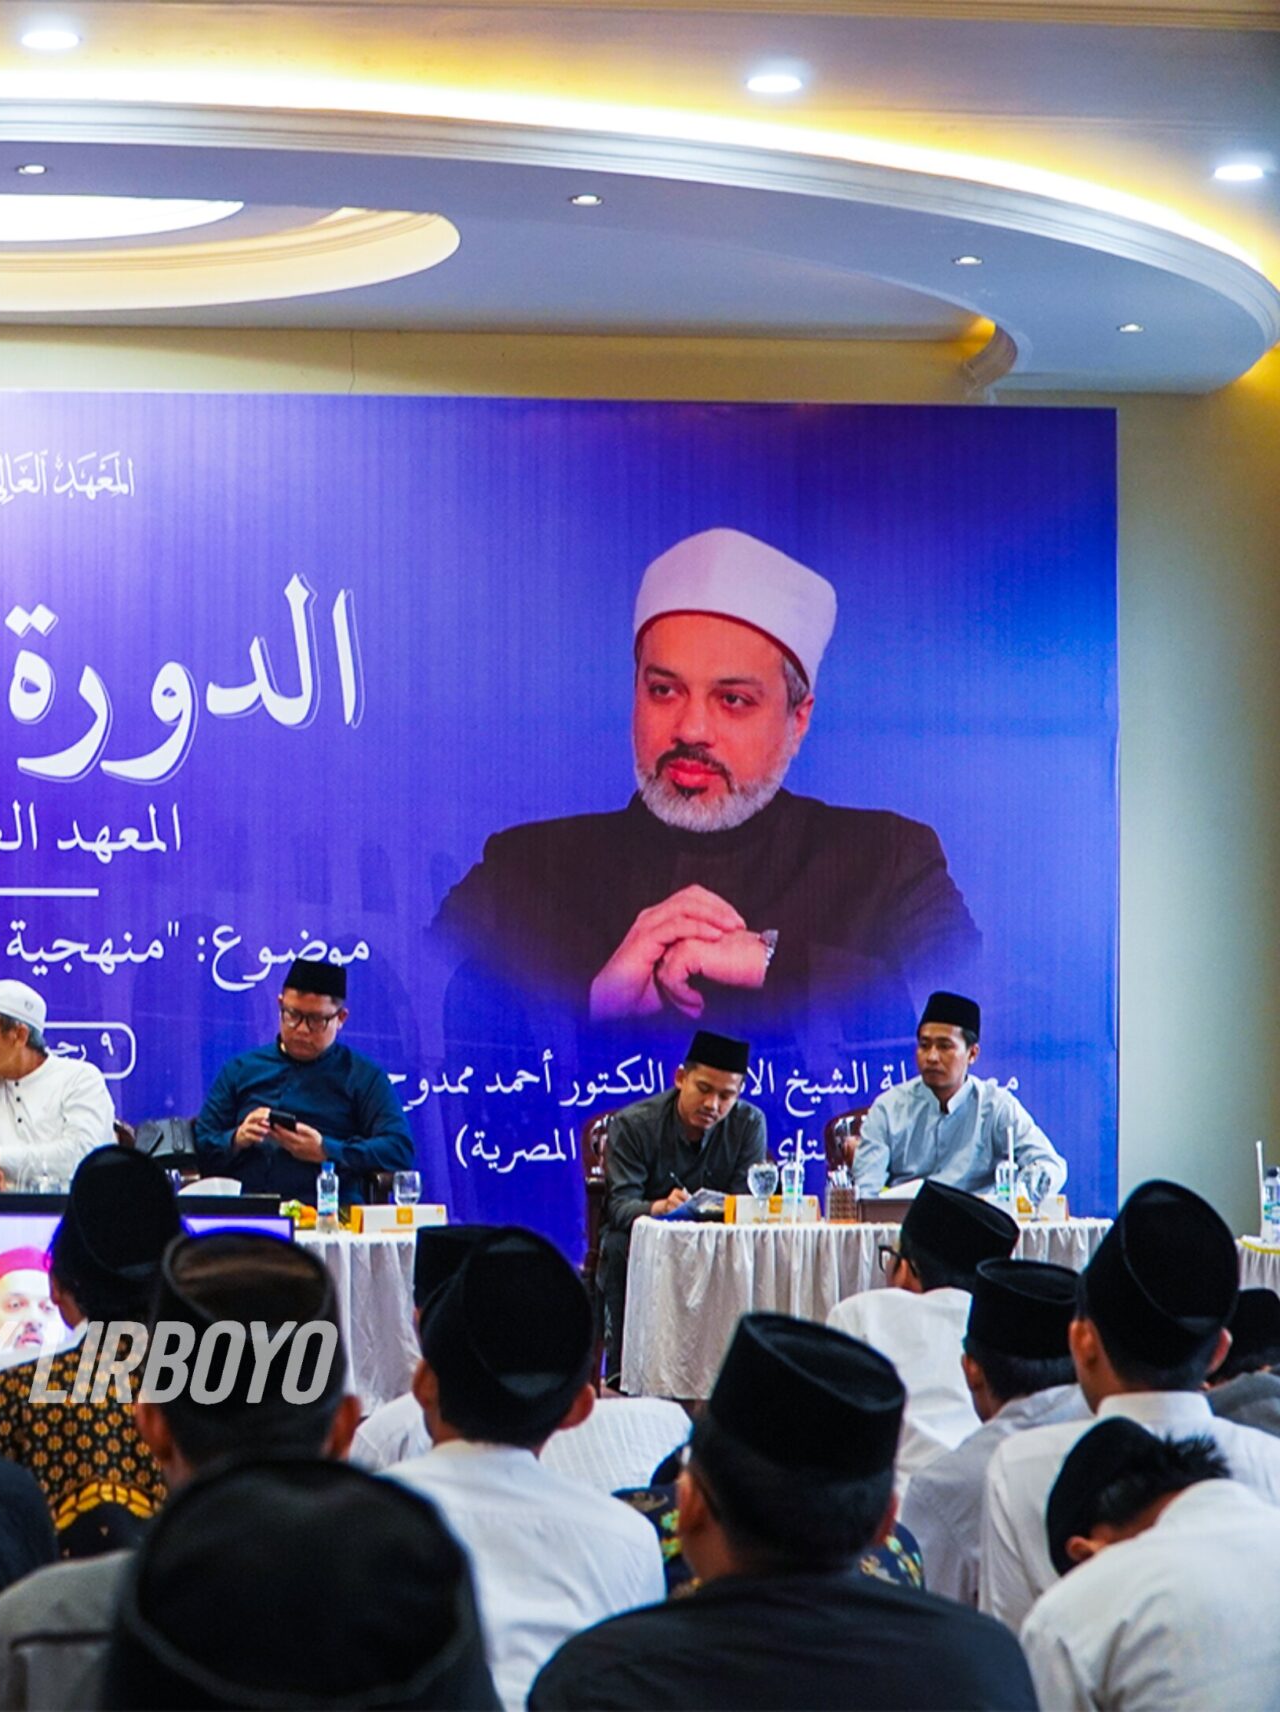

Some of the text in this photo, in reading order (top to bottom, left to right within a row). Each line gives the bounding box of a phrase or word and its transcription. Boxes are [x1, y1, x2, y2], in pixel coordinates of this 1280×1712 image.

[5, 573, 362, 784] الدورة
[57, 803, 182, 864] المعهد
[485, 1049, 554, 1093] أحمد
[785, 1060, 869, 1118] الشيخ
